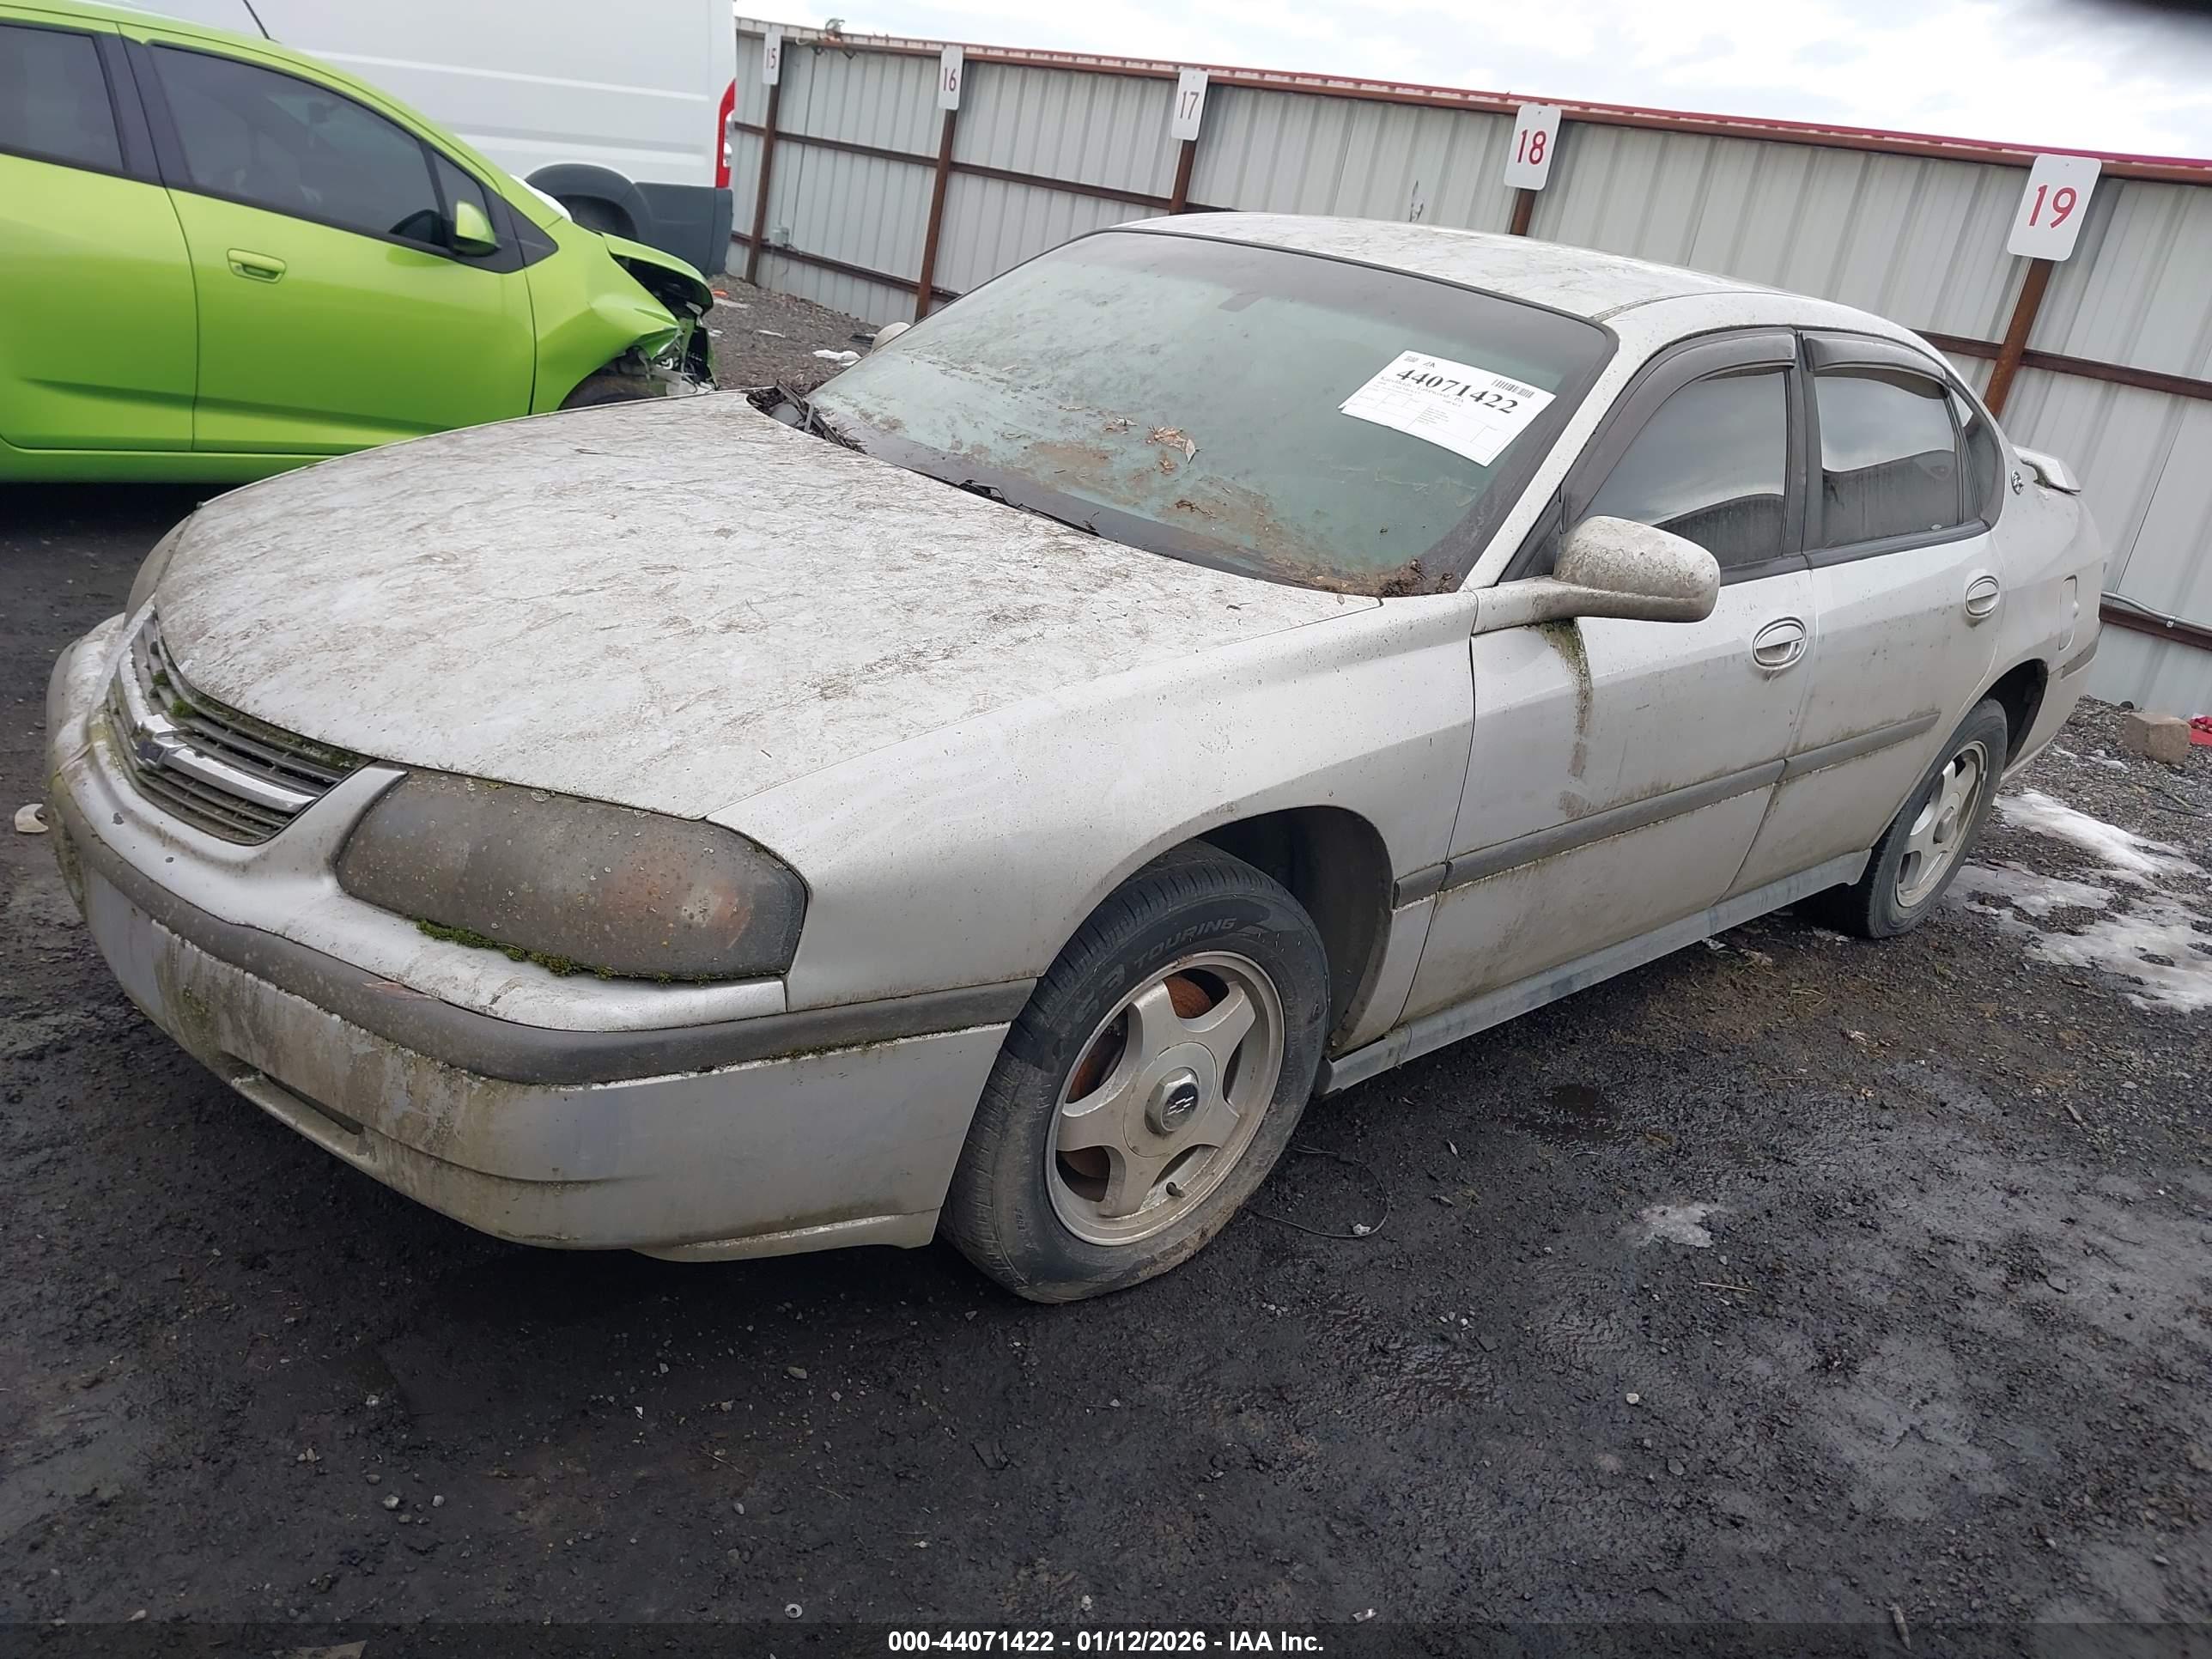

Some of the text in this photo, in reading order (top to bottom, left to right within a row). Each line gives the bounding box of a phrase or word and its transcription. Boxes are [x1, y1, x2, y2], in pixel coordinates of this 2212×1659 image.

[767, 47, 777, 70] 15
[943, 67, 957, 92] 16
[1179, 90, 1200, 120] 17
[1516, 129, 1547, 165] 18
[2028, 184, 2077, 228] 19
[1395, 368, 1519, 414] 44071422
[1134, 917, 1237, 969] TOURING
